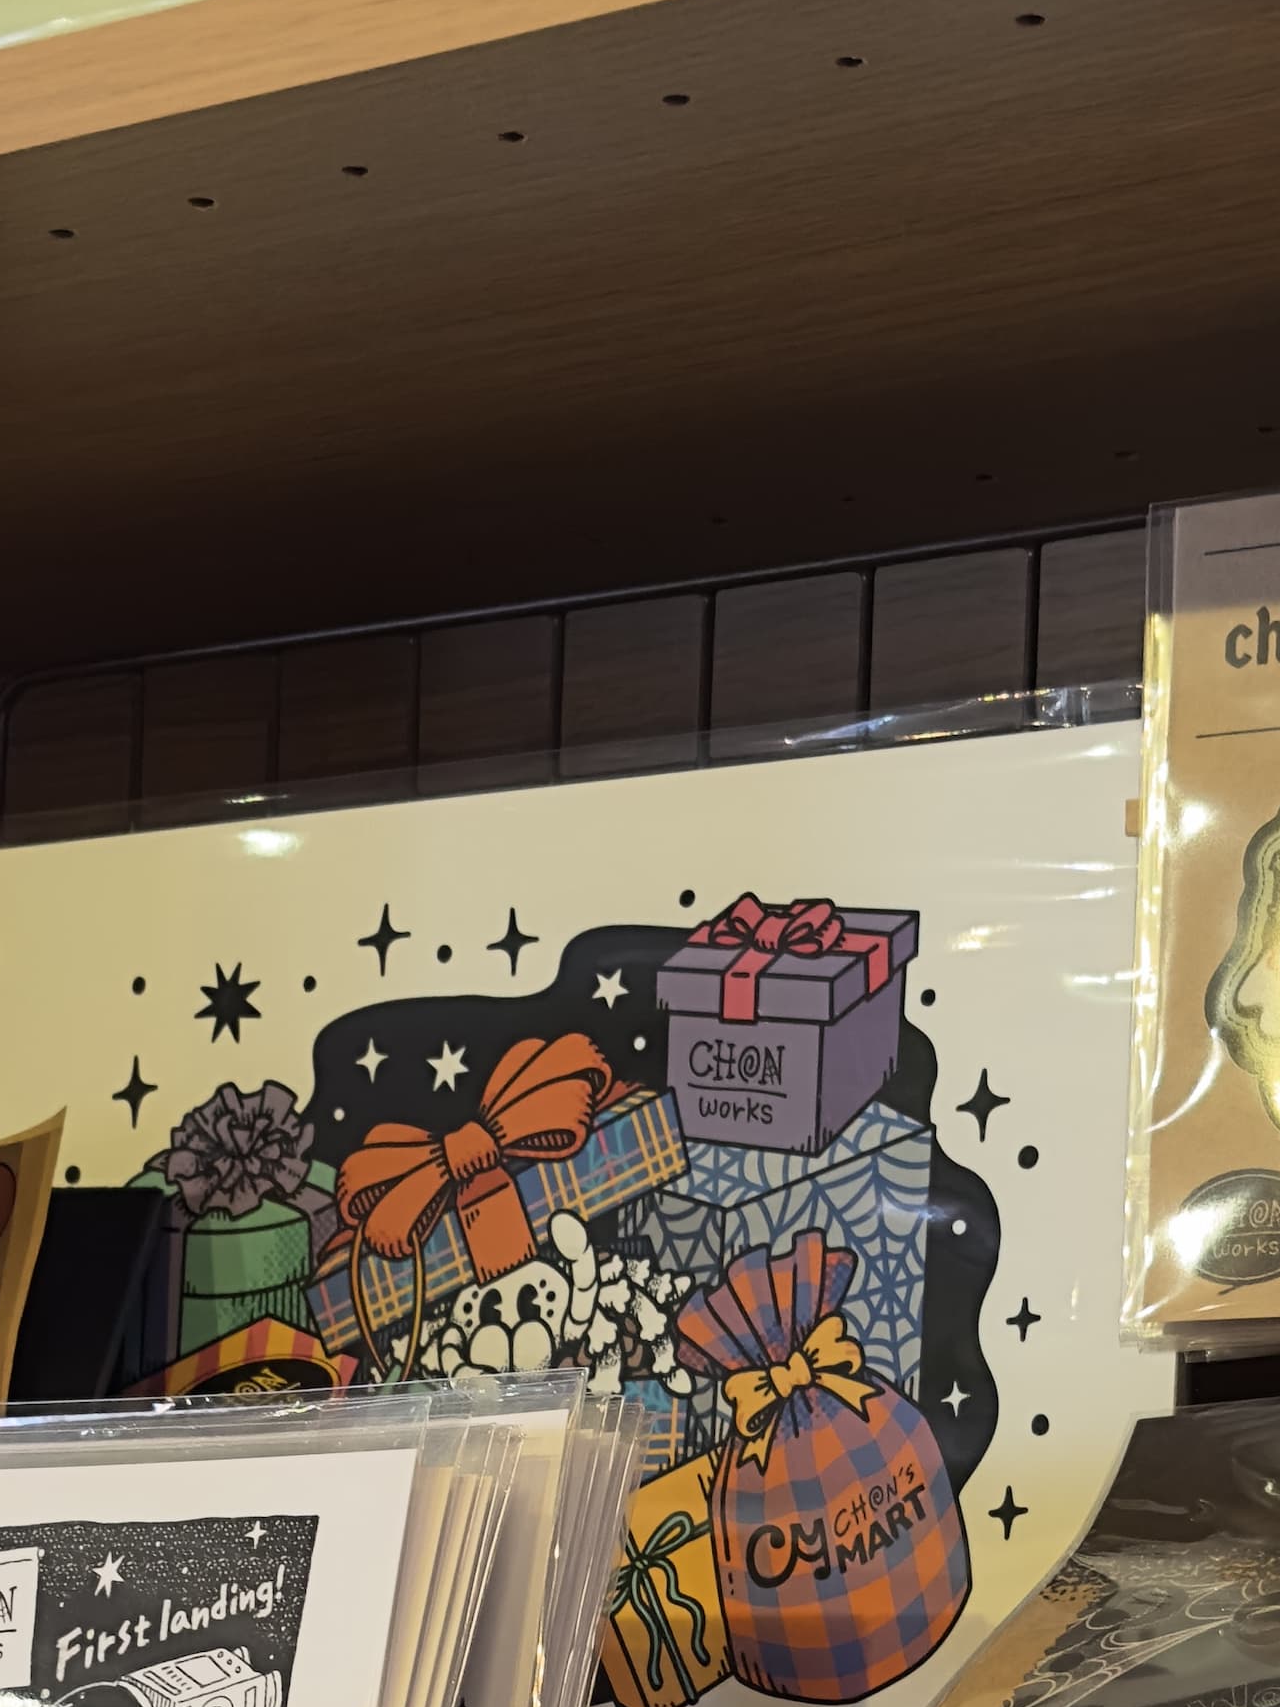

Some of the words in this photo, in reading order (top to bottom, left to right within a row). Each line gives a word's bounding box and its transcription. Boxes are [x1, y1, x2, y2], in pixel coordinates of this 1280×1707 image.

[698, 1096, 774, 1126] works
[835, 1483, 928, 1576] MART
[55, 1614, 152, 1682] First
[160, 1564, 286, 1644] landing!
